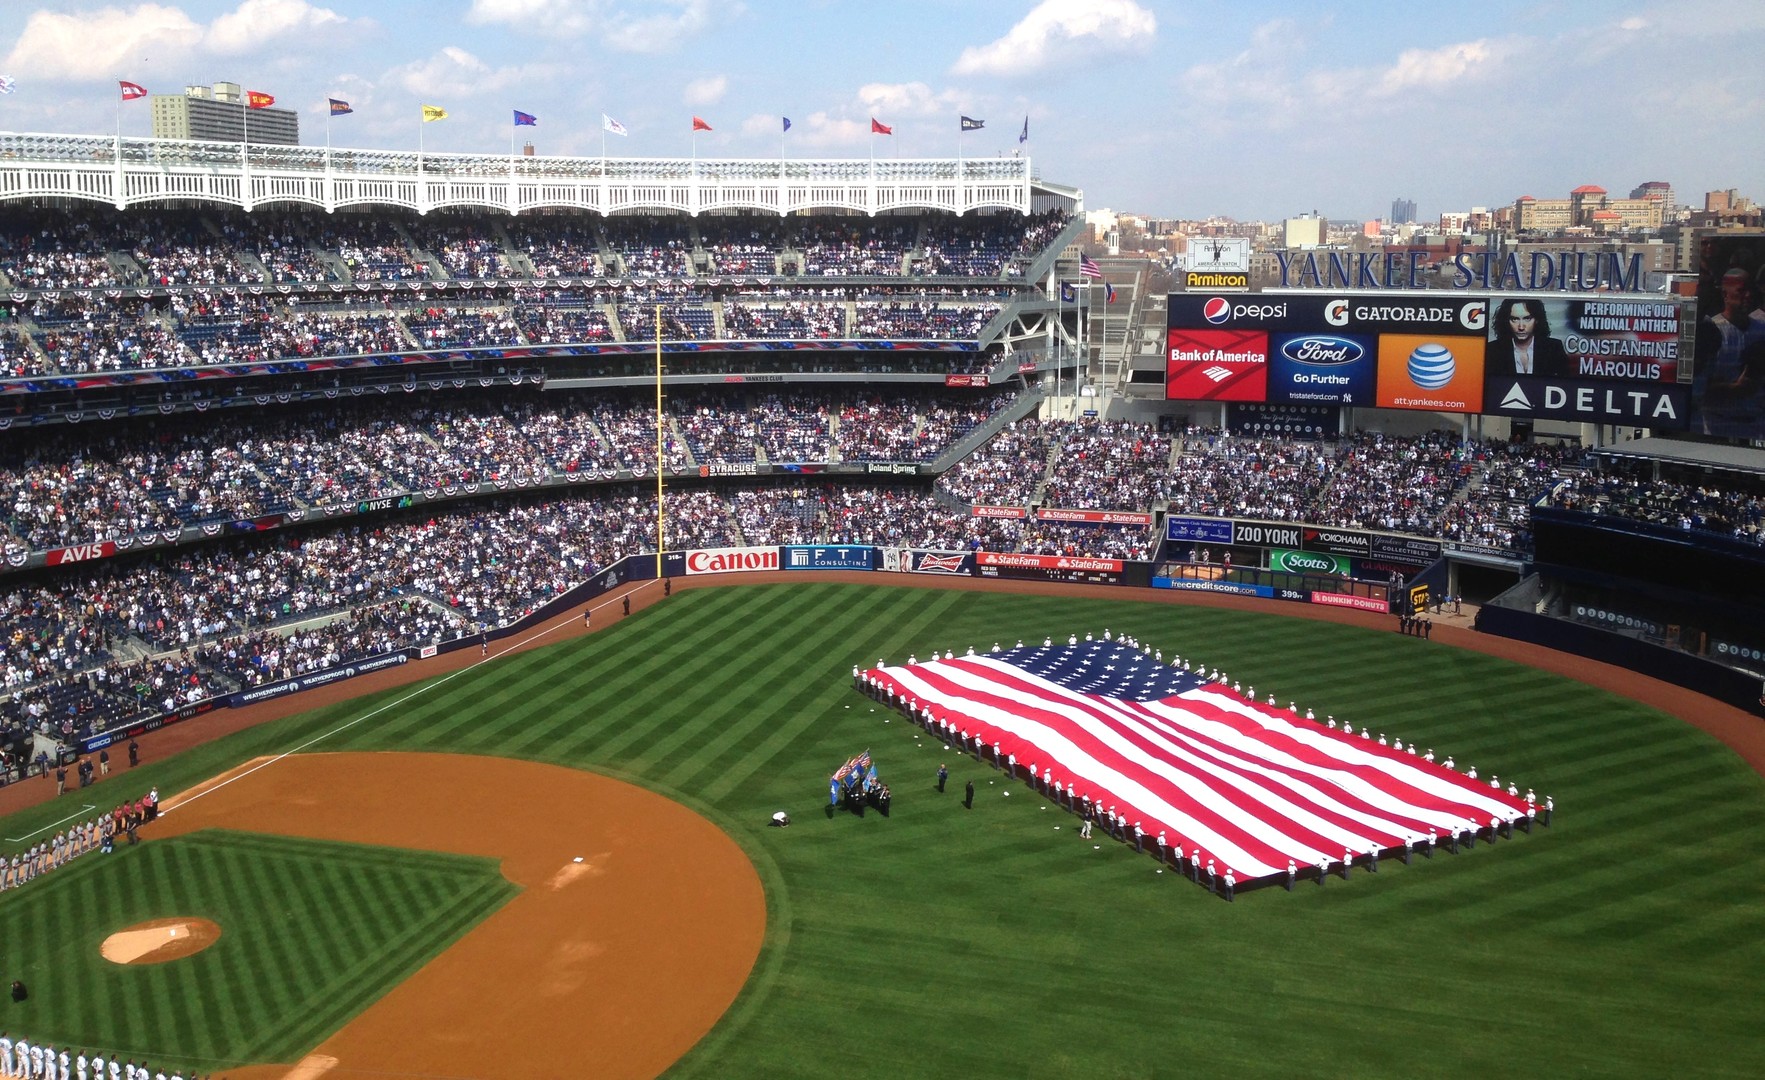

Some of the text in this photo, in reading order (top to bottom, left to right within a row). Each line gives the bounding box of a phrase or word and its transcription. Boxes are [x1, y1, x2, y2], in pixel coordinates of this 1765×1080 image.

[1274, 250, 1645, 292] YANKEE STADIUM
[1187, 272, 1246, 286] Armitron
[1233, 302, 1287, 320] pepsi
[1355, 306, 1453, 323] GATORADE
[1584, 302, 1675, 318] PERFORMING OUR
[1580, 316, 1678, 333] NATIONAL ANTHEM
[1297, 339, 1348, 362] Ford
[1565, 334, 1678, 359] CONSTANTINE
[1171, 348, 1265, 363] Bank of America
[1579, 356, 1661, 380] MAROULIS
[1293, 373, 1350, 385] Go Further
[1289, 391, 1339, 401] tristateford.com
[1394, 396, 1466, 409] att.yankees.com
[1545, 385, 1677, 420] DELTA
[709, 464, 757, 473] SYRACUSE
[868, 463, 917, 475] Poland Spring
[370, 499, 392, 511] NYSE
[1236, 526, 1262, 543] ZOO
[1264, 528, 1299, 546] YORK
[1319, 532, 1368, 546] YOKOHAMA
[60, 544, 102, 564] AVIS
[815, 549, 868, 560] FTI
[1382, 545, 1429, 557] COLLECTIBLES
[1460, 544, 1517, 558] pinstripebowl.com
[688, 551, 778, 572] Canon
[814, 559, 867, 567] CONSULTING
[923, 557, 962, 566] Budweiser
[1289, 554, 1329, 570] Scotts
[1171, 579, 1257, 596] freecreditscore.com
[1321, 594, 1385, 611] DUNKIN' DONUTS
[358, 657, 398, 672] WEATHERPROOF
[302, 669, 345, 686] WEATHERPROOF
[242, 684, 289, 701] WEATHERPROOF
[196, 703, 213, 713] Audi
[163, 715, 179, 724] Audi
[128, 727, 145, 736] Audi
[87, 737, 111, 750] GEICO
